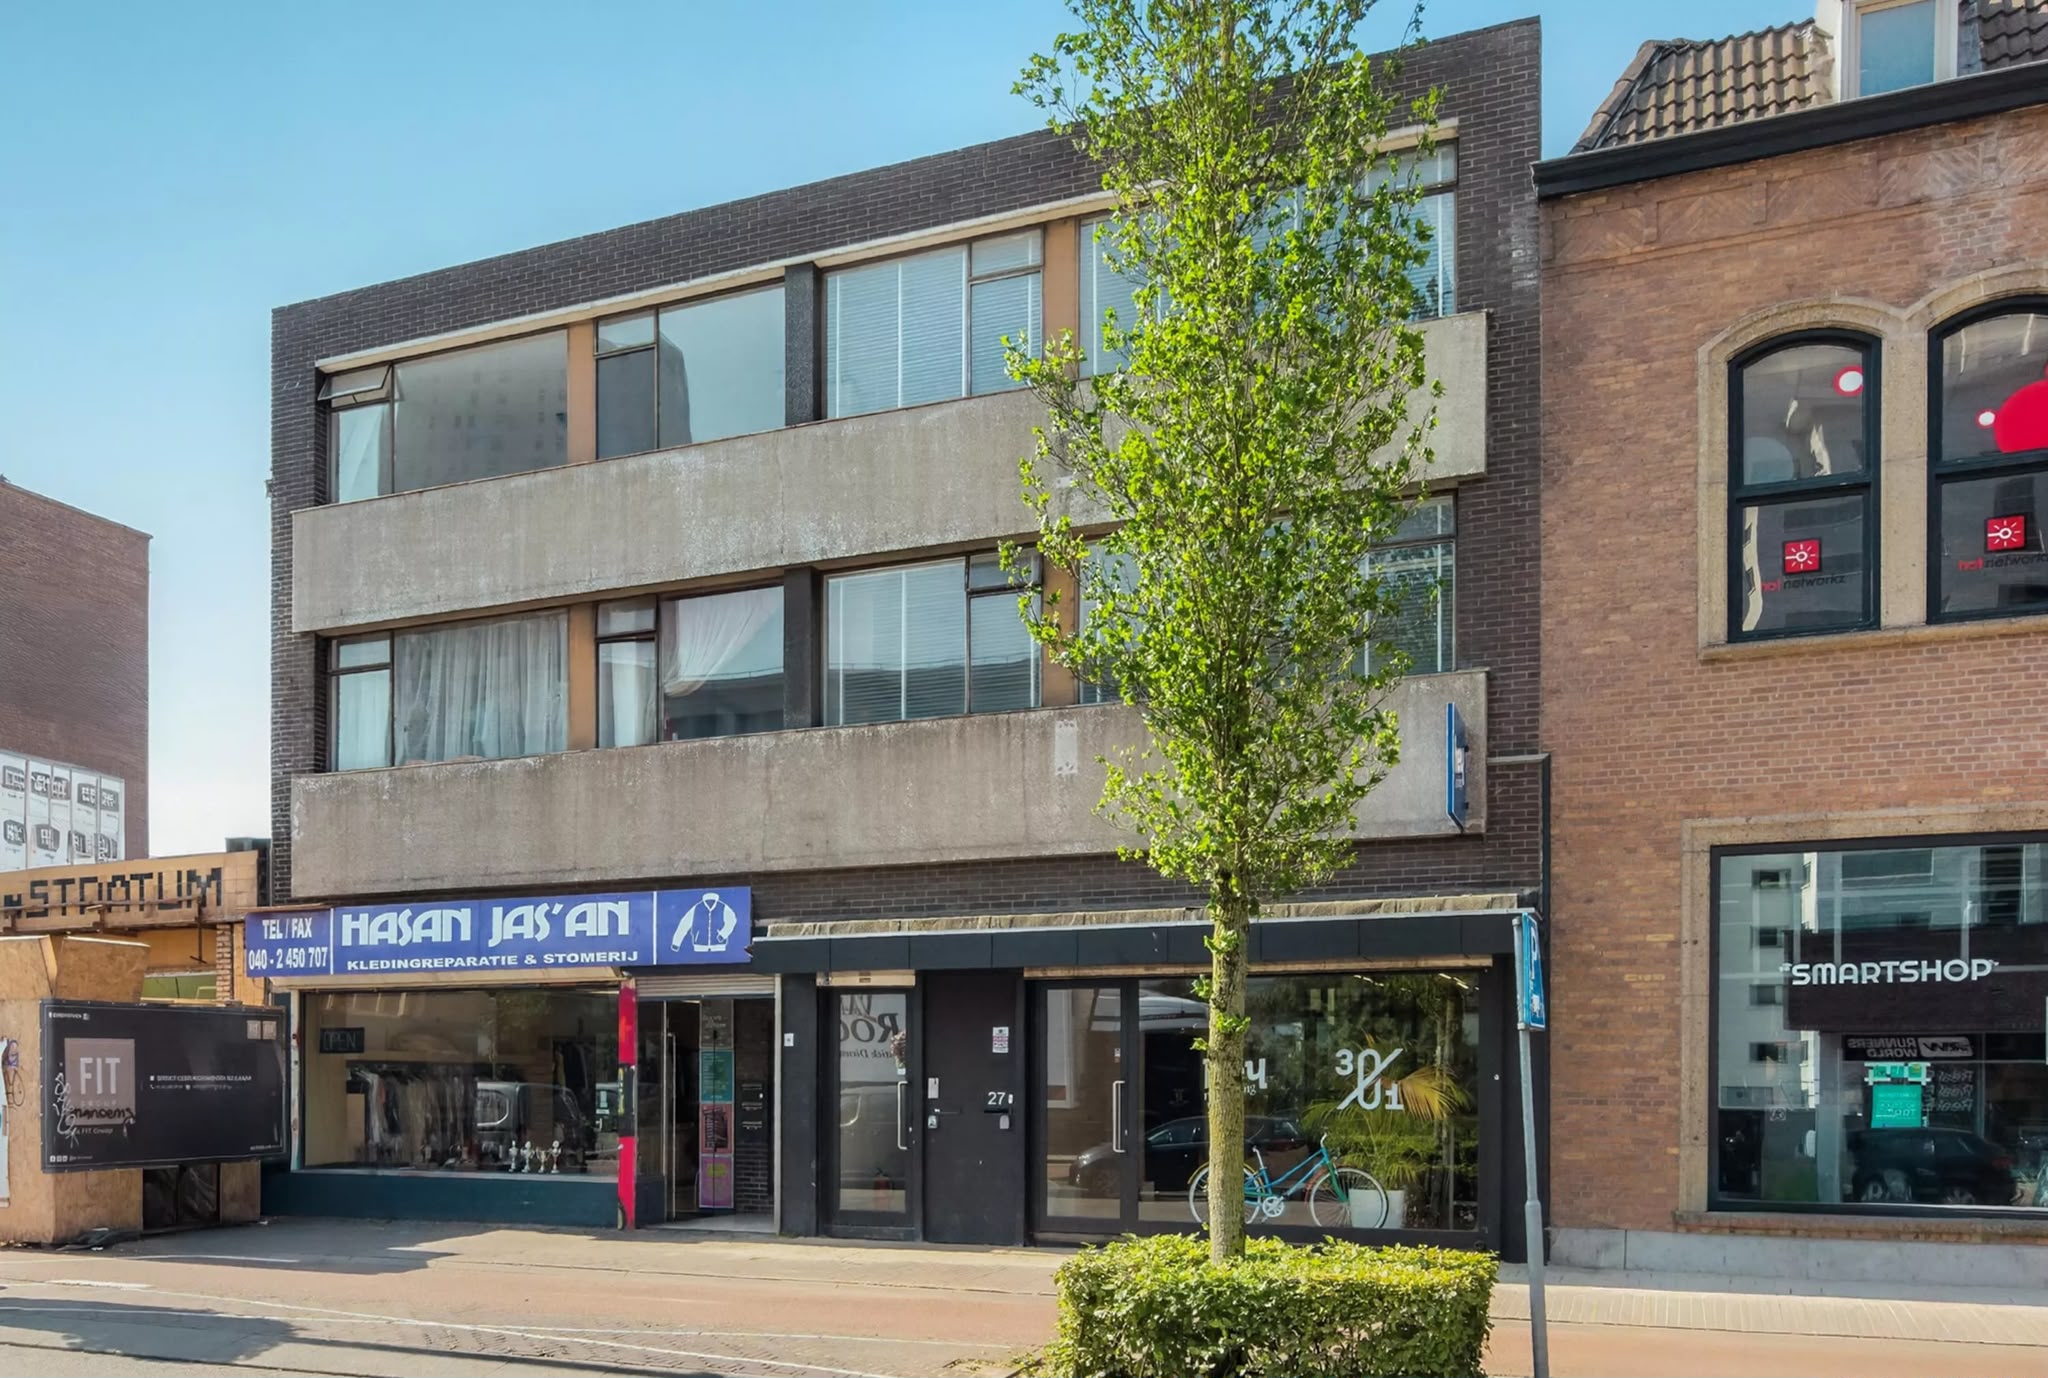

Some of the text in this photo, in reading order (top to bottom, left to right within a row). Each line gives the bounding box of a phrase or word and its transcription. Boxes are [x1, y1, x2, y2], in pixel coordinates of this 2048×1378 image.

[26, 867, 222, 918] STRATUM
[262, 919, 283, 940] TEL
[292, 917, 312, 939] FAX
[341, 901, 630, 948] HASAN JAS'AN
[249, 949, 267, 970] 040
[277, 948, 284, 968] 2
[285, 948, 306, 968] 450
[308, 947, 328, 968] 707
[347, 951, 638, 971] KLEDINGREPARATIE & STOMERIJ
[1791, 959, 1995, 986] SMARTSHOP
[80, 1057, 121, 1095] FIT
[987, 1091, 1006, 1105] 27
